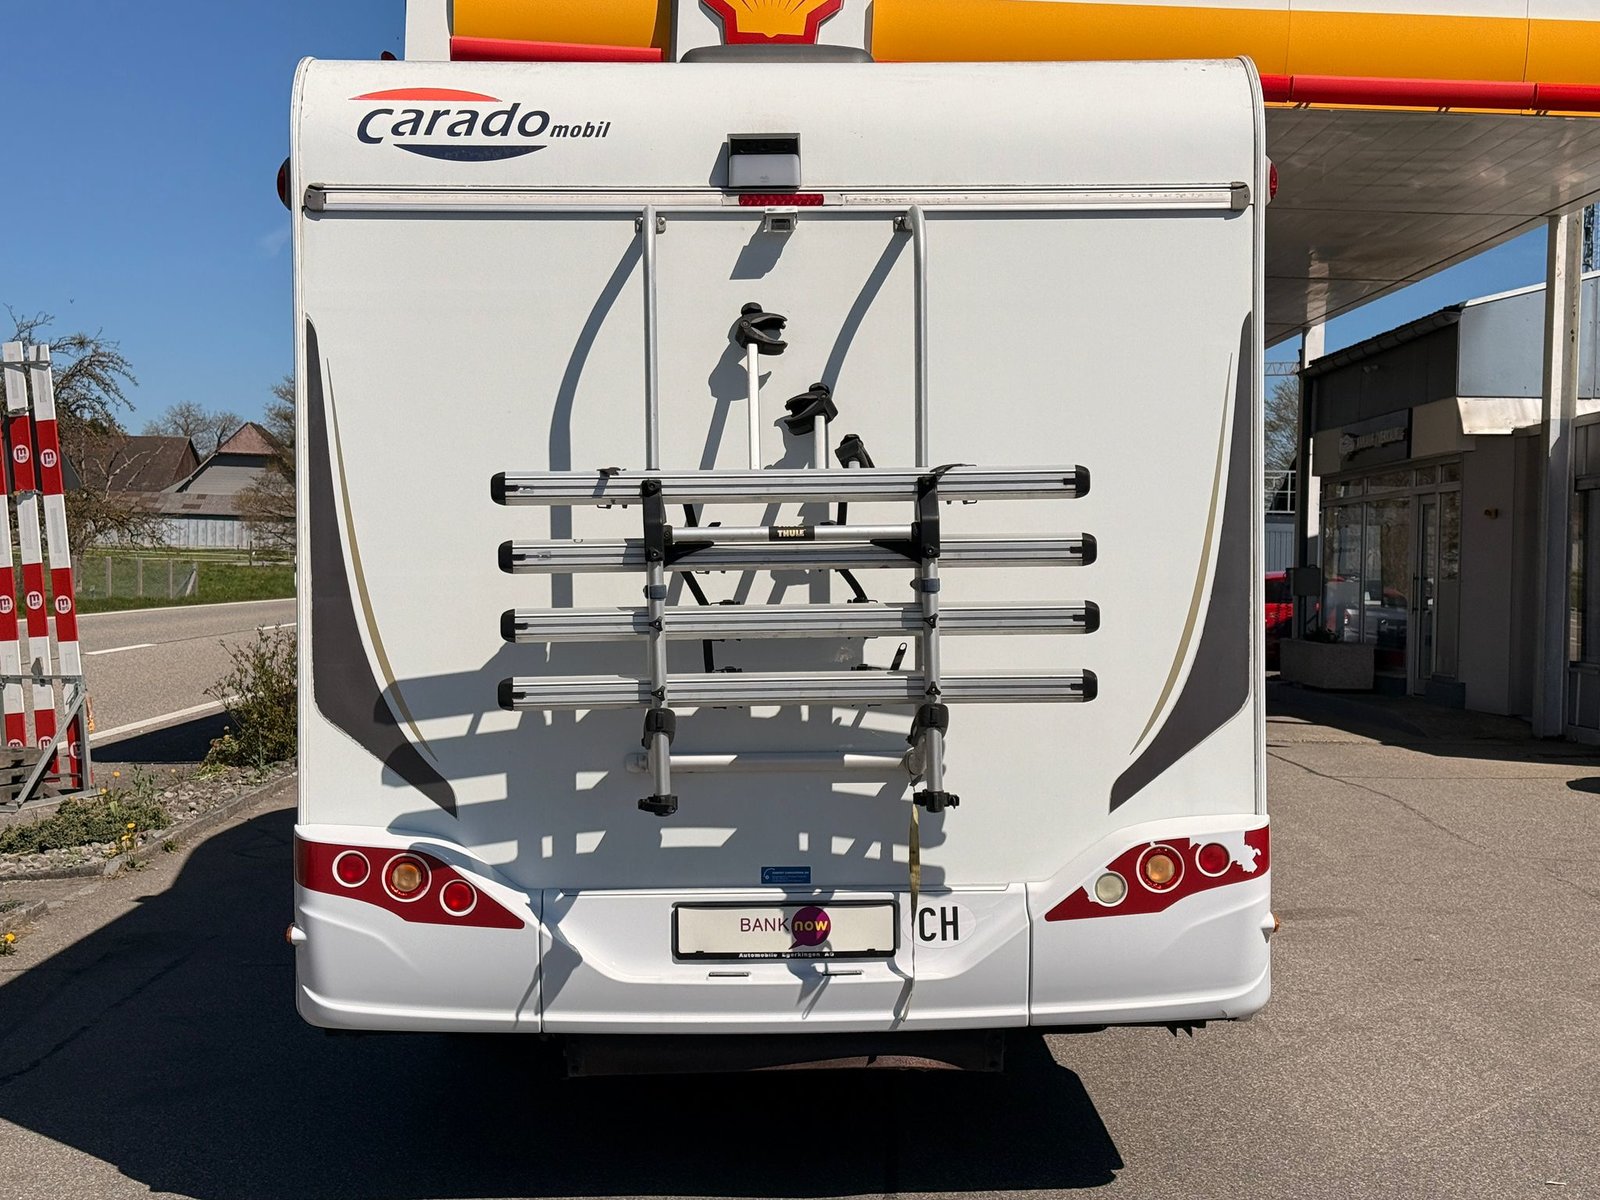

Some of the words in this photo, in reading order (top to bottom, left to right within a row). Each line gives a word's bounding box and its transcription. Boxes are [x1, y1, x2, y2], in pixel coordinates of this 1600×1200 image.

[356, 102, 550, 144] carado
[550, 121, 611, 138] mobil
[777, 529, 805, 537] THULE
[740, 917, 790, 932] BANK
[794, 919, 829, 931] now
[918, 906, 959, 941] CH
